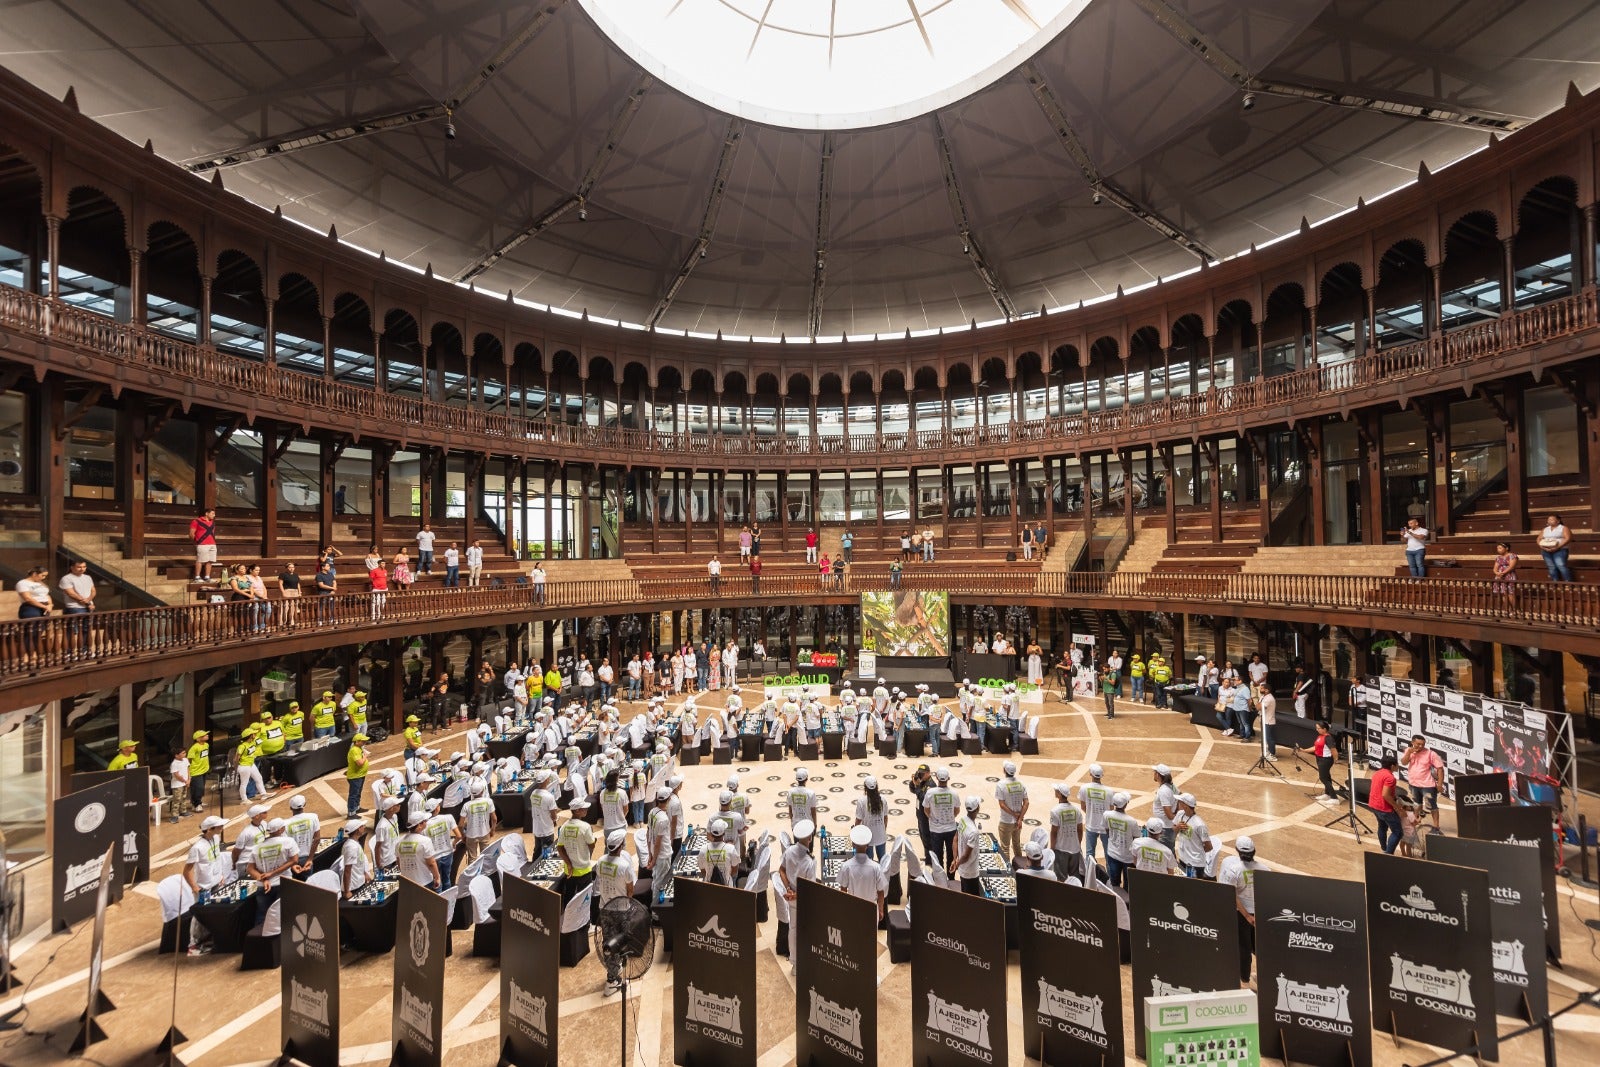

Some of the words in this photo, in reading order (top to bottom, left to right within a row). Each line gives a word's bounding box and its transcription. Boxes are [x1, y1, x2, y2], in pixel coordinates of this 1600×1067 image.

[764, 674, 829, 686] COOSALUD
[1440, 742, 1471, 756] COOSALUD
[1463, 792, 1503, 804] COOSALUD
[1030, 907, 1071, 929] Termo
[1302, 912, 1356, 929] Iderbol
[1380, 901, 1459, 926] Comfenalco
[927, 931, 967, 953] Gestión
[1033, 920, 1103, 948] candelaria
[968, 957, 990, 970] salud
[1405, 969, 1456, 987] AJEDREZ
[516, 994, 540, 1013] AJEDREZ
[1050, 994, 1091, 1012] AJEDREZ
[1290, 990, 1336, 1004] AJEDREZ
[697, 999, 731, 1015] AJEDREZ
[818, 1004, 851, 1026] AJEDREZ
[1195, 1004, 1247, 1018] COOSALUD
[1415, 996, 1476, 1018] COOSALUD
[301, 1016, 330, 1038] COOSALUD
[939, 1008, 978, 1027] AJEDREZ
[1298, 1016, 1353, 1034] COOSALUD
[408, 1028, 434, 1053] COOSALUD
[519, 1023, 548, 1047] COOSALUD
[702, 1027, 743, 1046] COOSALUD
[1058, 1022, 1107, 1046] COOSALUD
[823, 1034, 864, 1061] COOSALUD
[945, 1037, 993, 1062] COOSALUD
